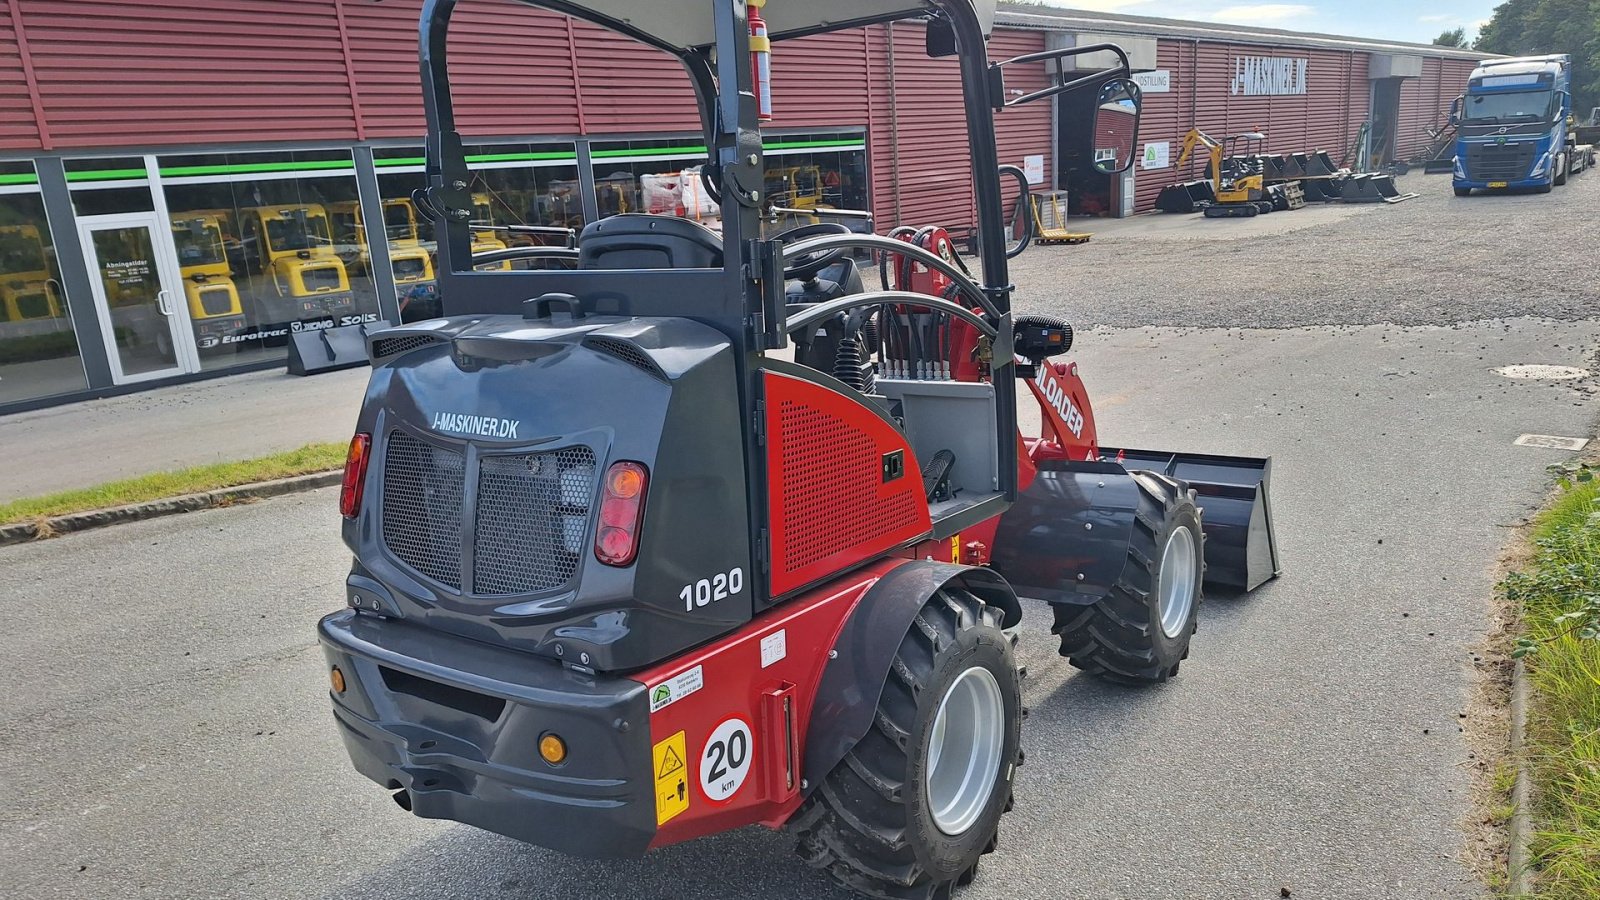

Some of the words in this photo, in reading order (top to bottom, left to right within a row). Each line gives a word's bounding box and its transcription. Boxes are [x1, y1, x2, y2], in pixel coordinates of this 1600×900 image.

[1231, 56, 1308, 96] J-MASKINER.DK
[221, 328, 288, 344] Eurotrac
[431, 411, 520, 439] J-MASKINER.DK
[679, 567, 743, 612] 1020
[707, 729, 747, 784] 20
[721, 779, 735, 793] km
